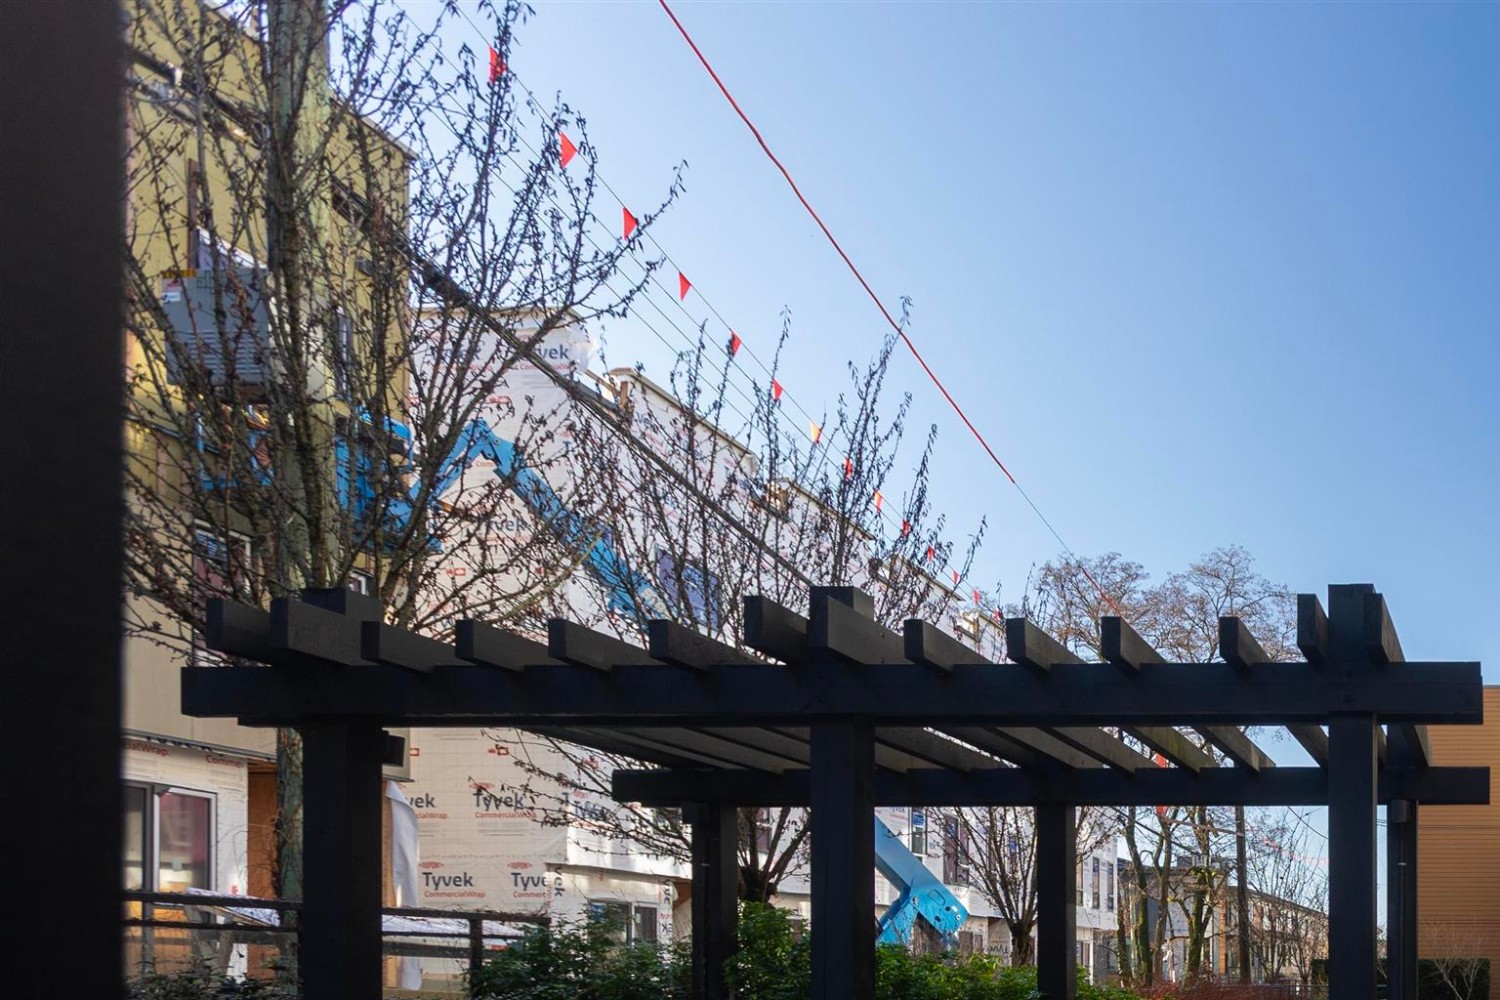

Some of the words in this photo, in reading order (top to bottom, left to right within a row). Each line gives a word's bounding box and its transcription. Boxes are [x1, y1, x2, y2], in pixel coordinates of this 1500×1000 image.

[538, 344, 569, 360] vek
[406, 792, 435, 808] vek
[473, 792, 524, 811] Tyvek
[422, 872, 474, 891] Tyvek
[510, 872, 547, 891] Tyve
